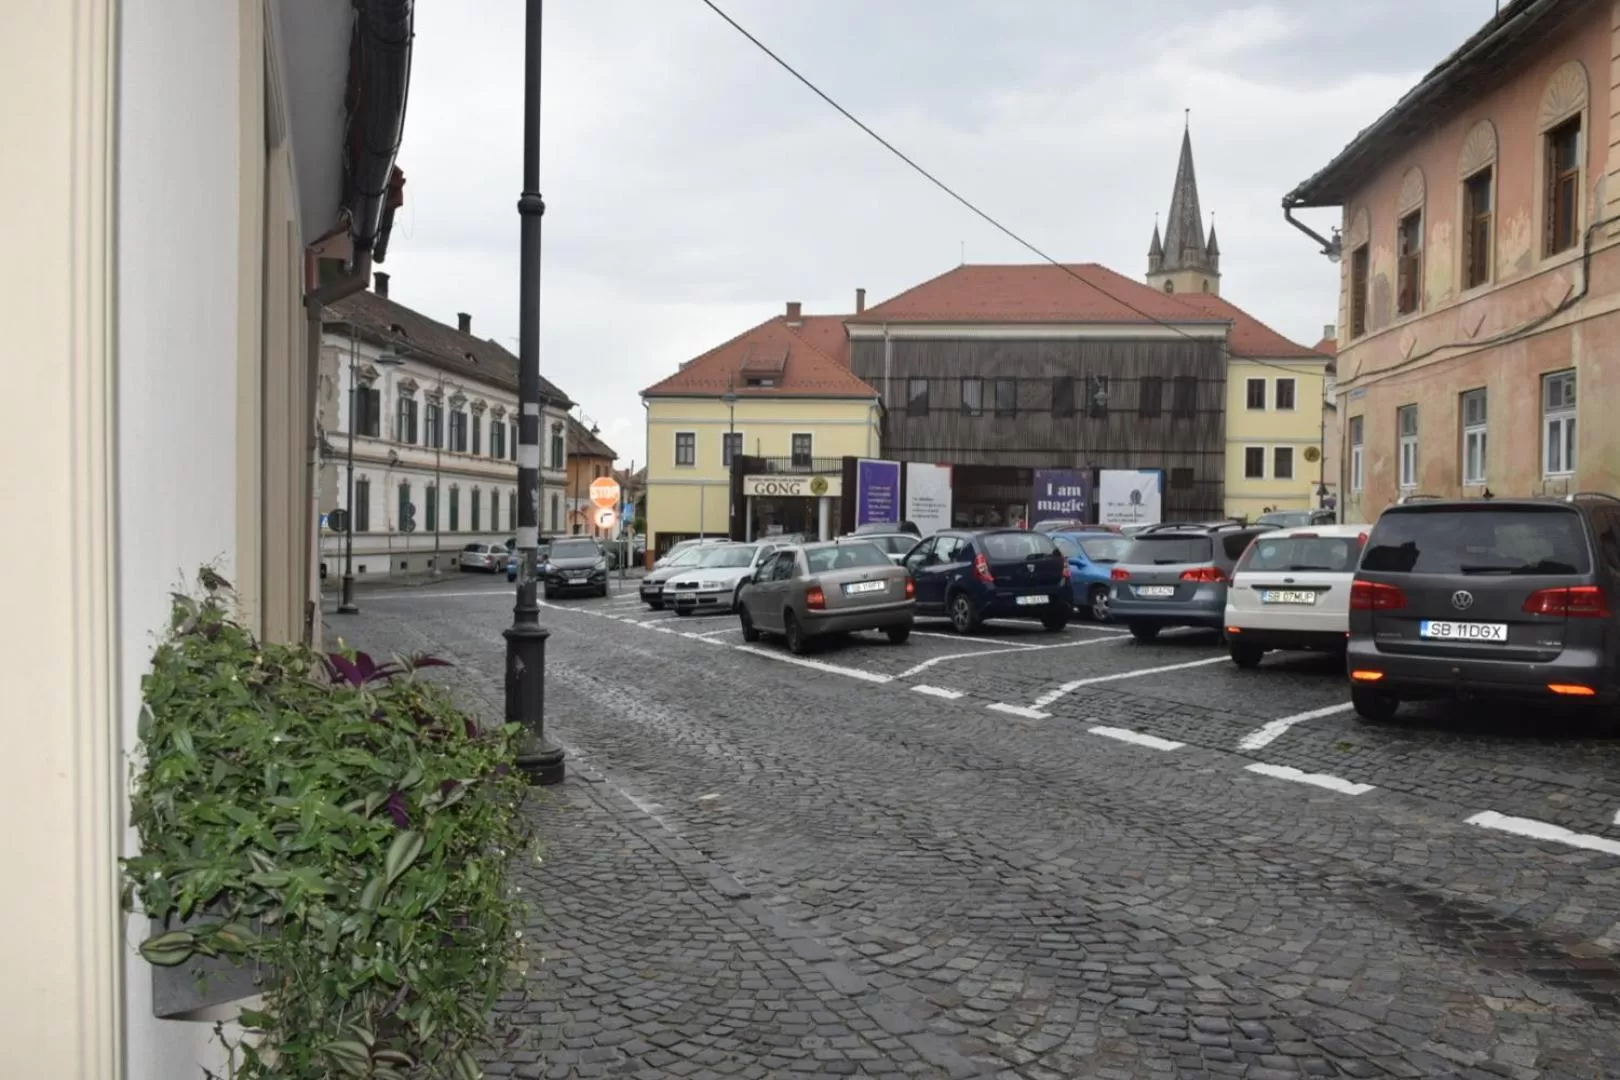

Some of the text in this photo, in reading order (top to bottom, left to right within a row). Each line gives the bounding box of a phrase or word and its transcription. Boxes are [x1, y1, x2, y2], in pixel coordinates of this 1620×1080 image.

[754, 482, 800, 495] GONG
[1057, 486, 1081, 497] am
[1037, 499, 1085, 513] magic
[1431, 623, 1501, 639] SB 11DGX
